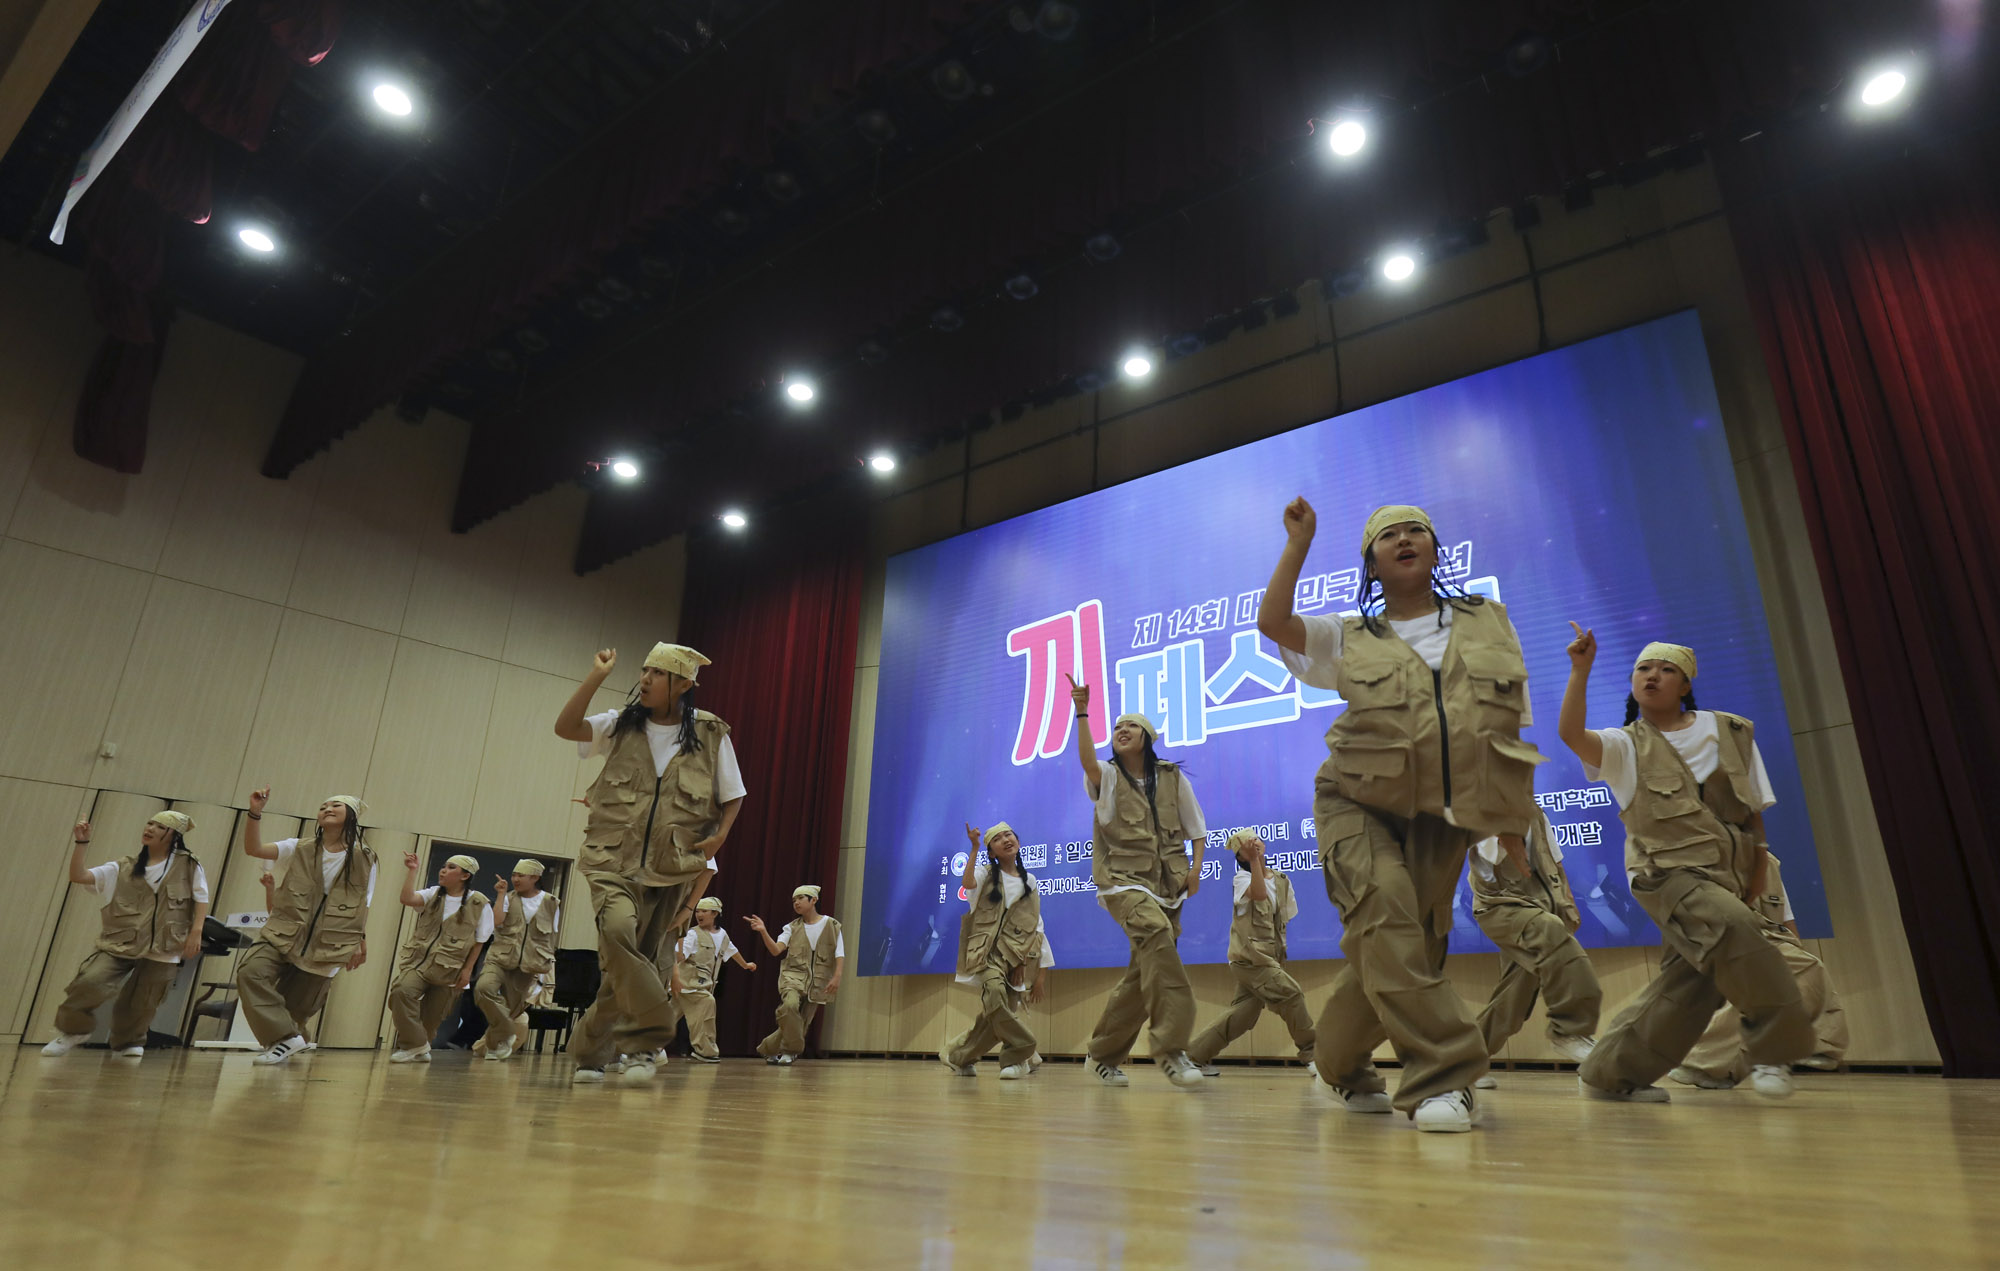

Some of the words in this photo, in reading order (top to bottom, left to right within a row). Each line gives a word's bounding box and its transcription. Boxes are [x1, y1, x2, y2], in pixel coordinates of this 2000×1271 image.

[1132, 613, 1162, 648] 제
[1168, 597, 1228, 639] 14회
[1234, 567, 1360, 626] 대민국
[1007, 598, 1112, 766] 끼
